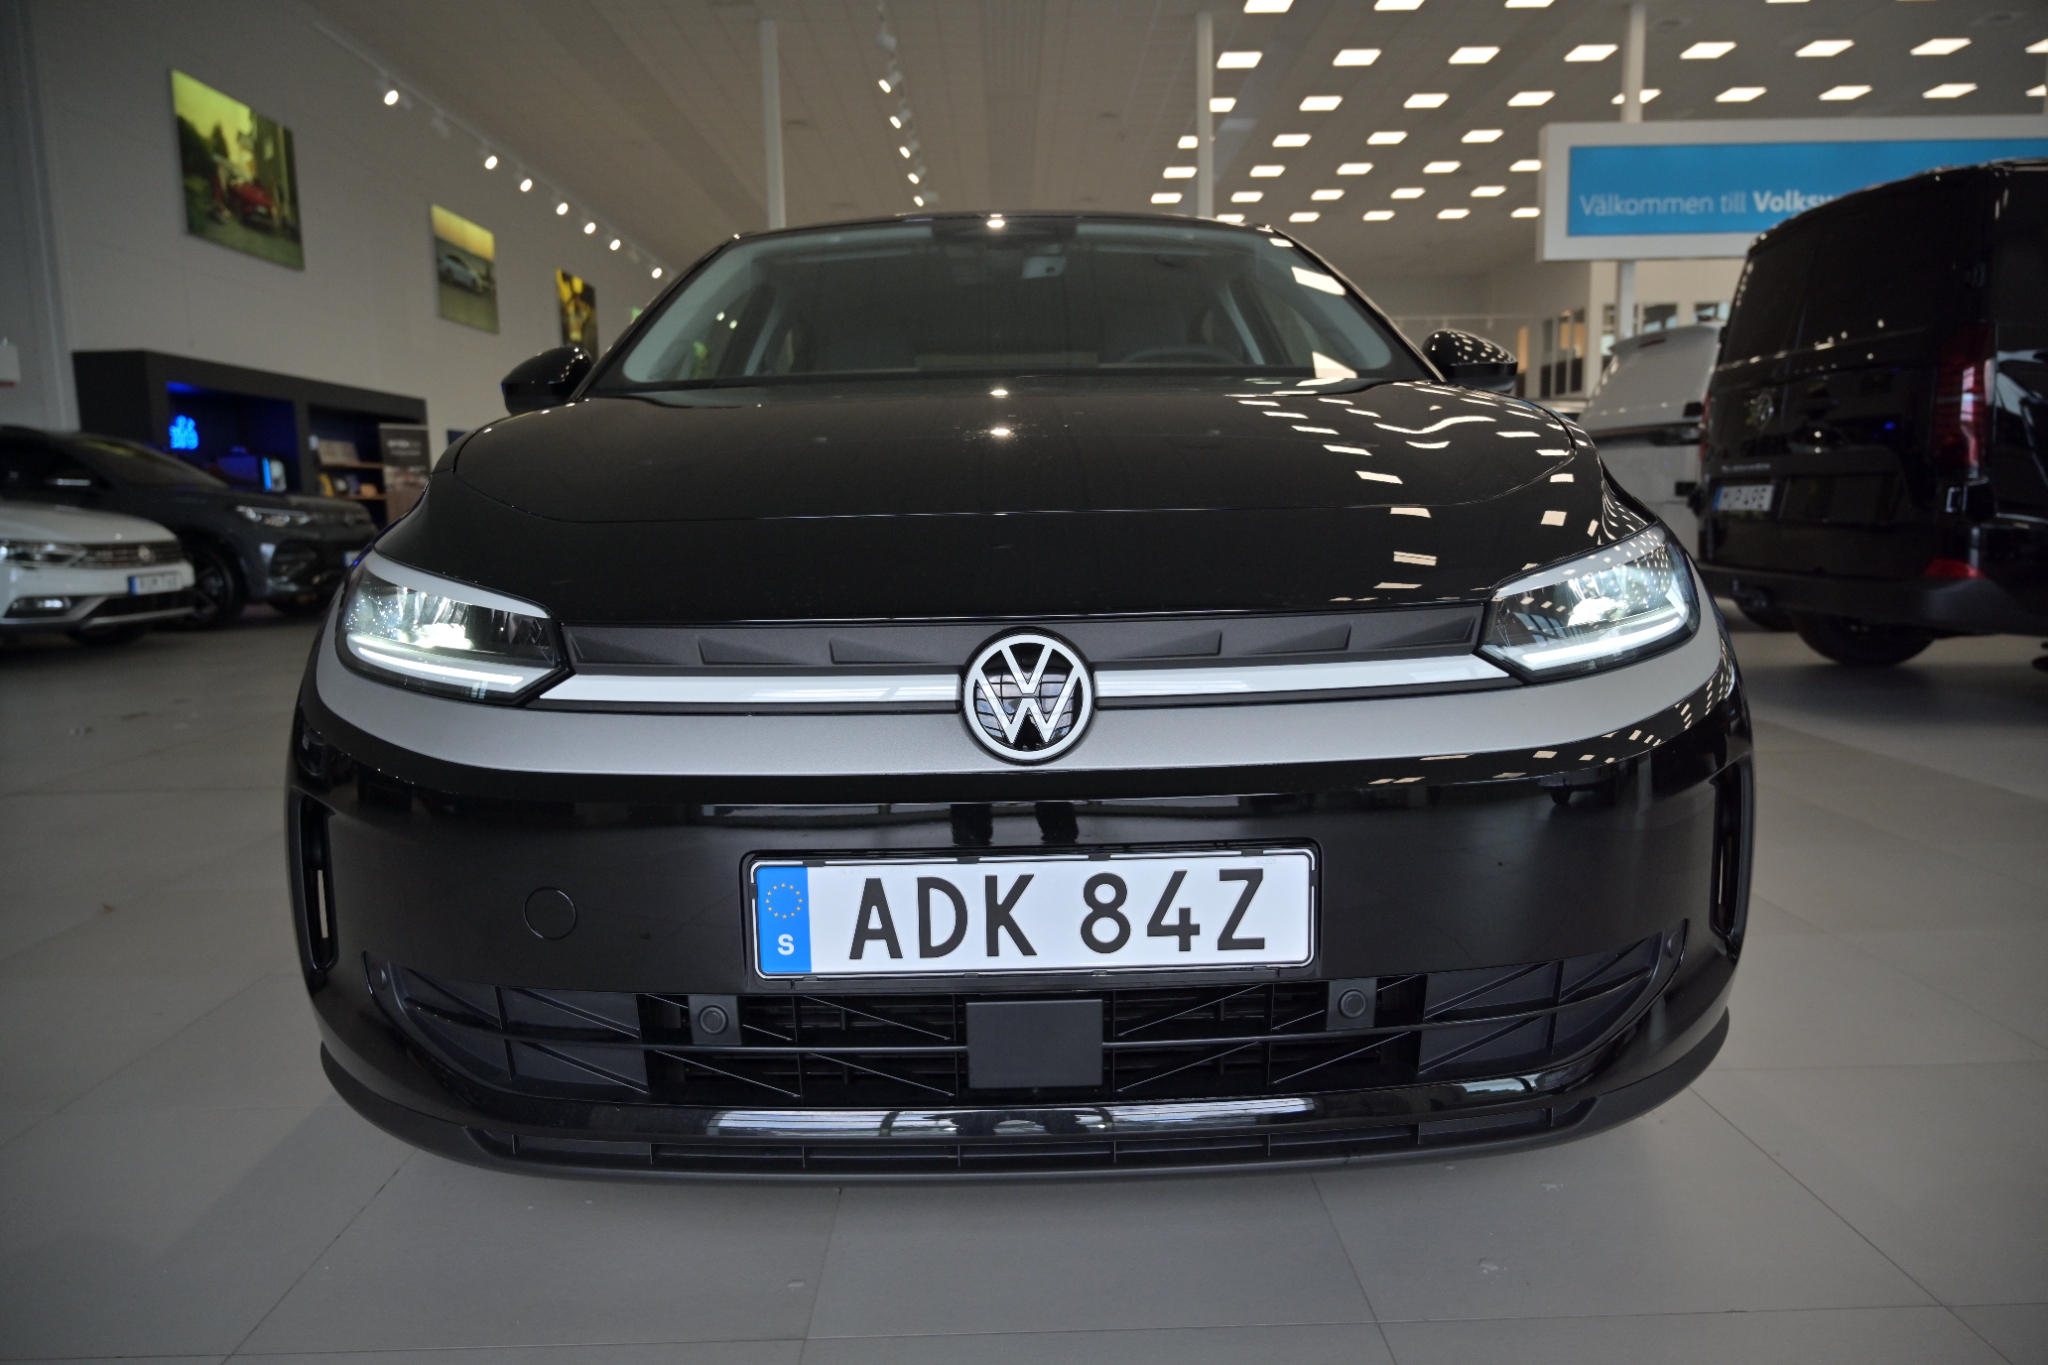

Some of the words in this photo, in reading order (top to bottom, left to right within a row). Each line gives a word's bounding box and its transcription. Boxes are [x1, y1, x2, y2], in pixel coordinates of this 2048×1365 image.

[1580, 193, 1714, 216] Välkommen
[1720, 191, 1747, 214] till
[1752, 188, 1836, 213] Volks
[849, 874, 1037, 959] ADK
[1081, 868, 1265, 953] 84Z
[777, 933, 795, 956] S
